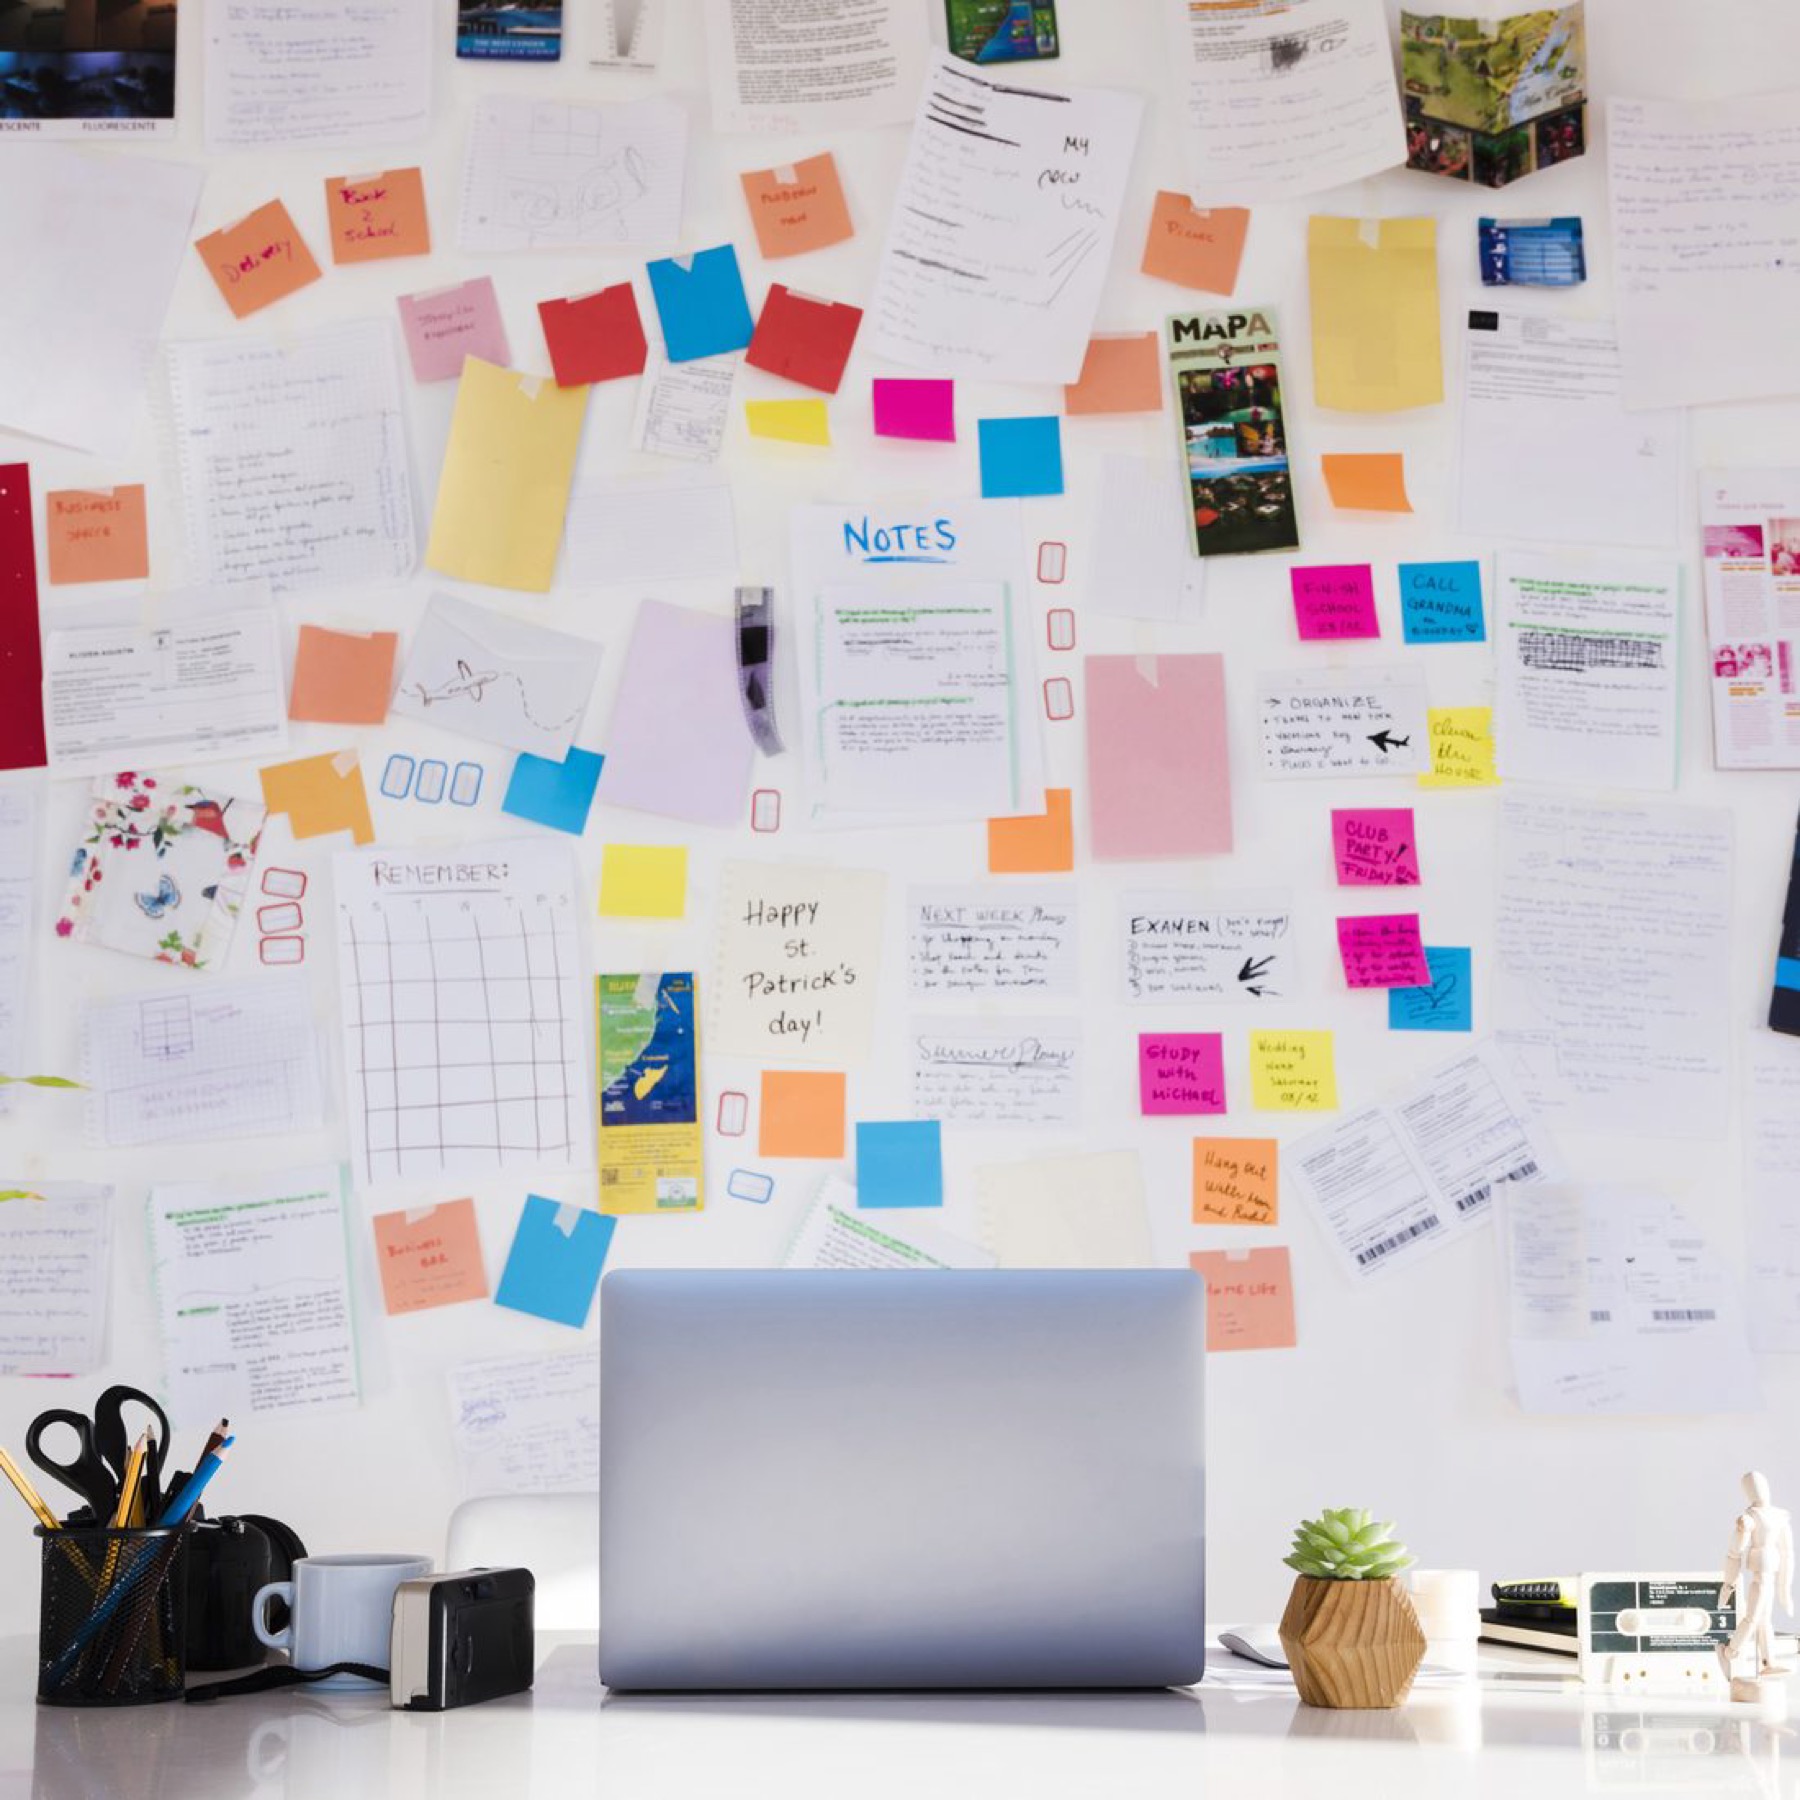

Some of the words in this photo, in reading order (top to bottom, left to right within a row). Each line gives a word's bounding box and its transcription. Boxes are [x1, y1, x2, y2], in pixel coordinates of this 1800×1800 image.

[1172, 312, 1273, 343] MAPA
[843, 515, 956, 554] NOTES
[1411, 572, 1461, 593] CALL
[1345, 820, 1389, 843] CLUB
[742, 899, 820, 928] Happy
[768, 1010, 822, 1043] day!
[1718, 1615, 1728, 1629] 3
